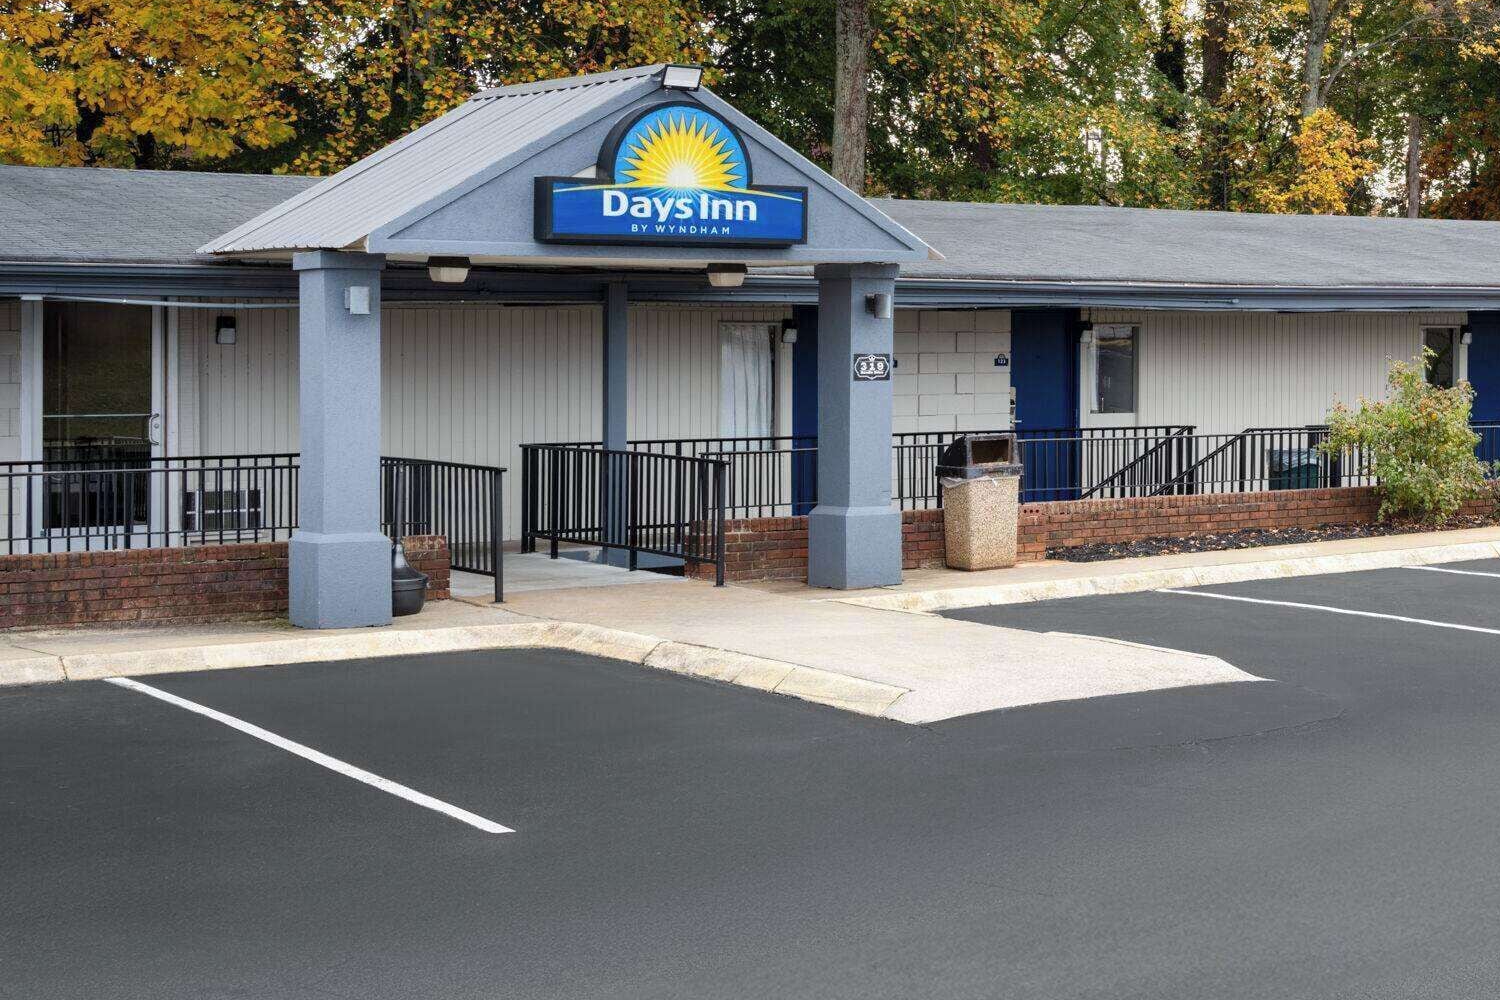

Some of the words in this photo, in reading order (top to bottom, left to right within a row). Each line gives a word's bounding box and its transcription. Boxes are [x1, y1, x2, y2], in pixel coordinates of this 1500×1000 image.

[602, 189, 693, 222] Days
[700, 194, 757, 221] Inn
[631, 223, 648, 233] BY
[655, 224, 730, 234] WYNDHAM
[860, 361, 884, 371] 319
